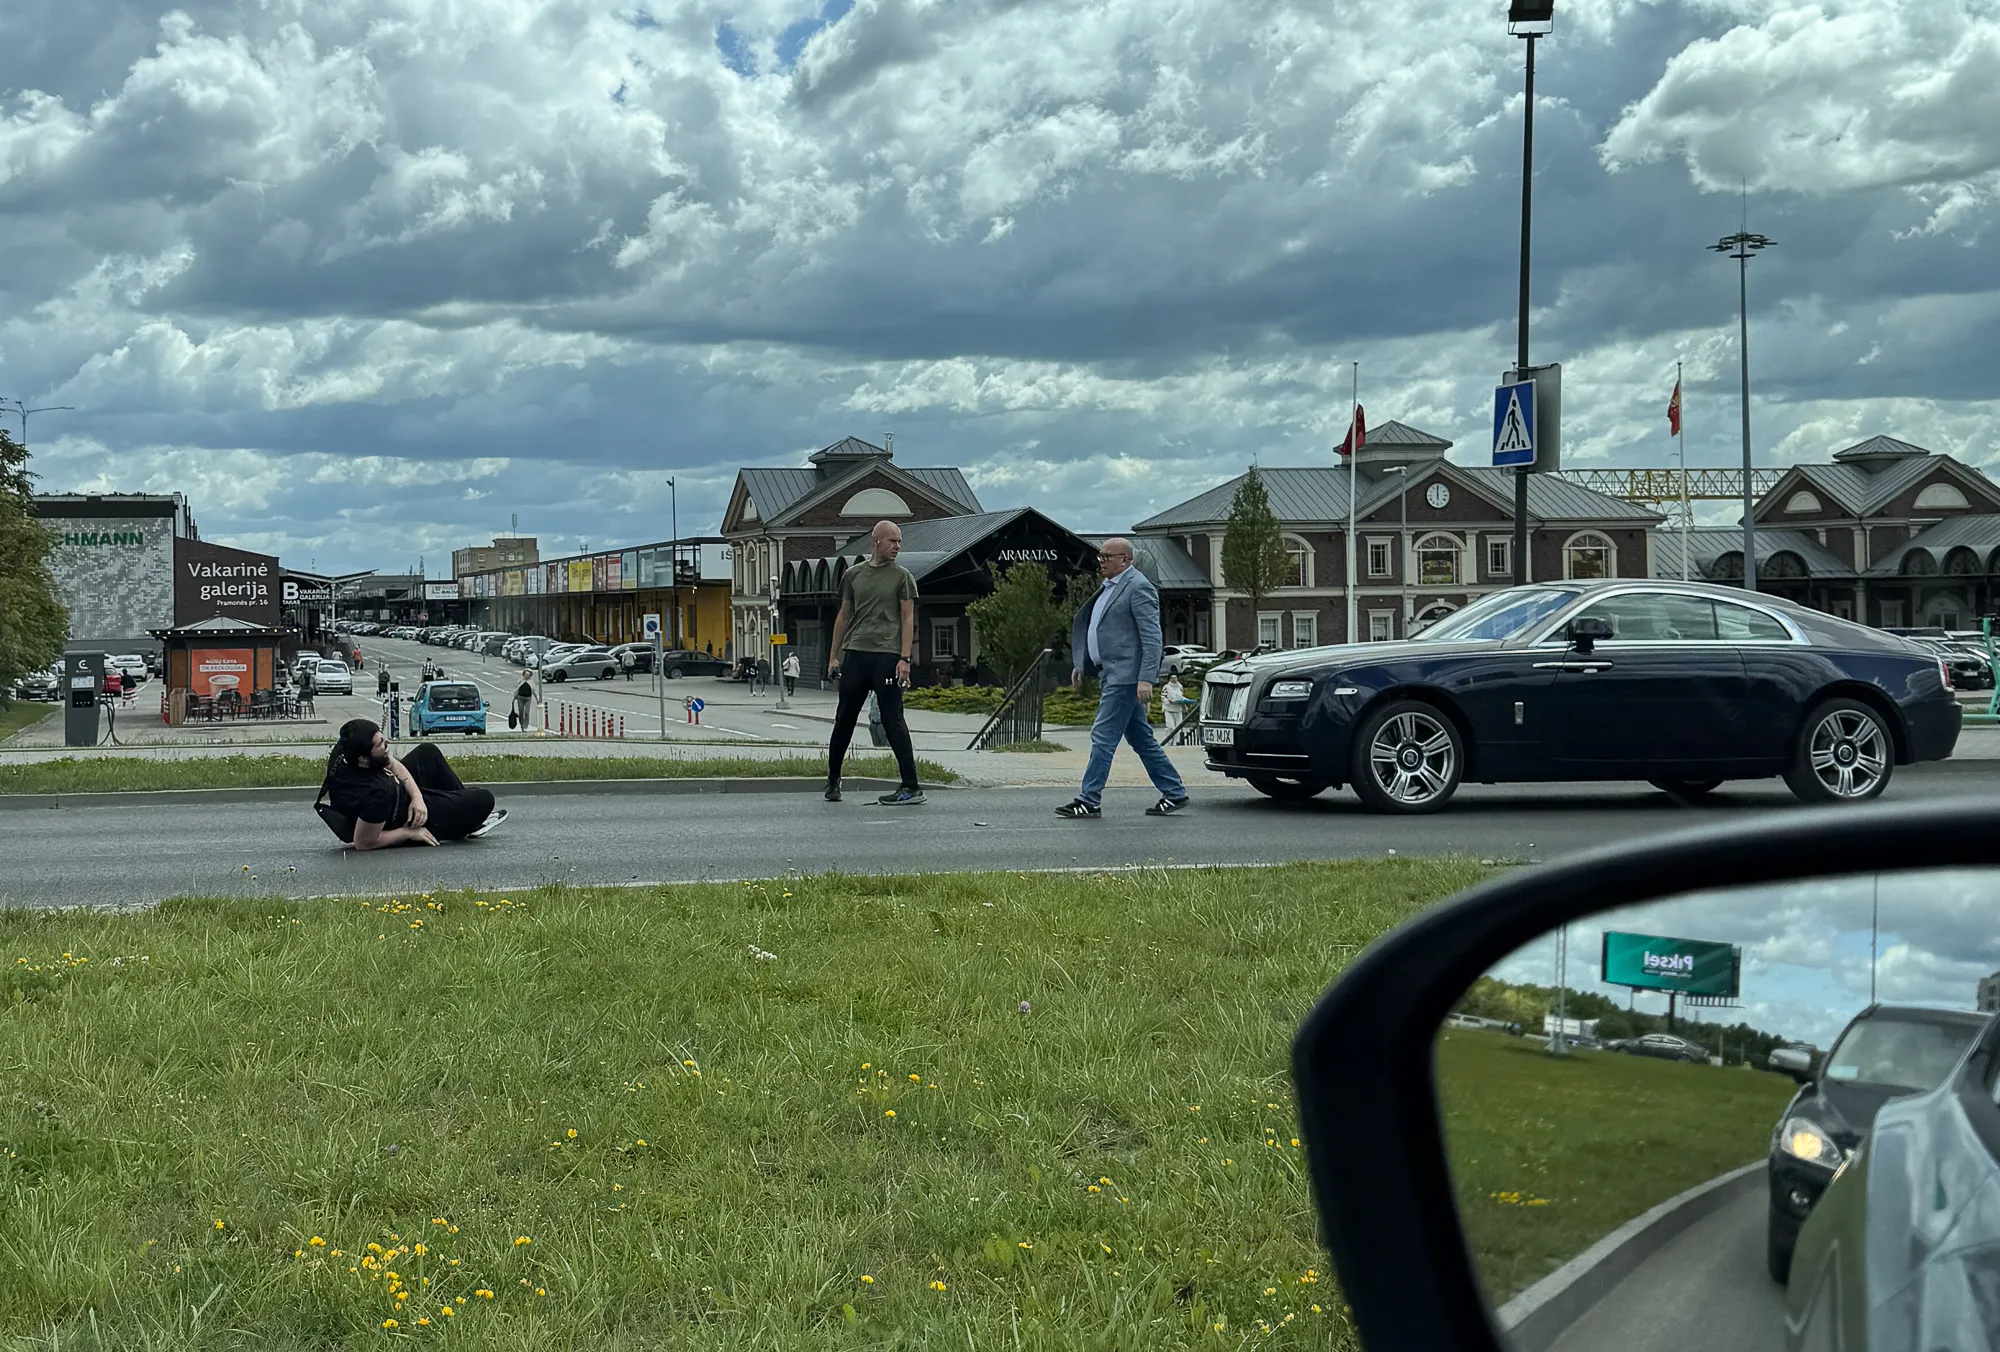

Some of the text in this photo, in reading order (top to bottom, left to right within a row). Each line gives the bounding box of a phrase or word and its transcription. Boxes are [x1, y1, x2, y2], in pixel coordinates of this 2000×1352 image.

[998, 549, 1058, 561] ARARATAS
[187, 562, 268, 577] Vakarinė
[200, 581, 268, 600] galerija
[283, 582, 299, 599] B
